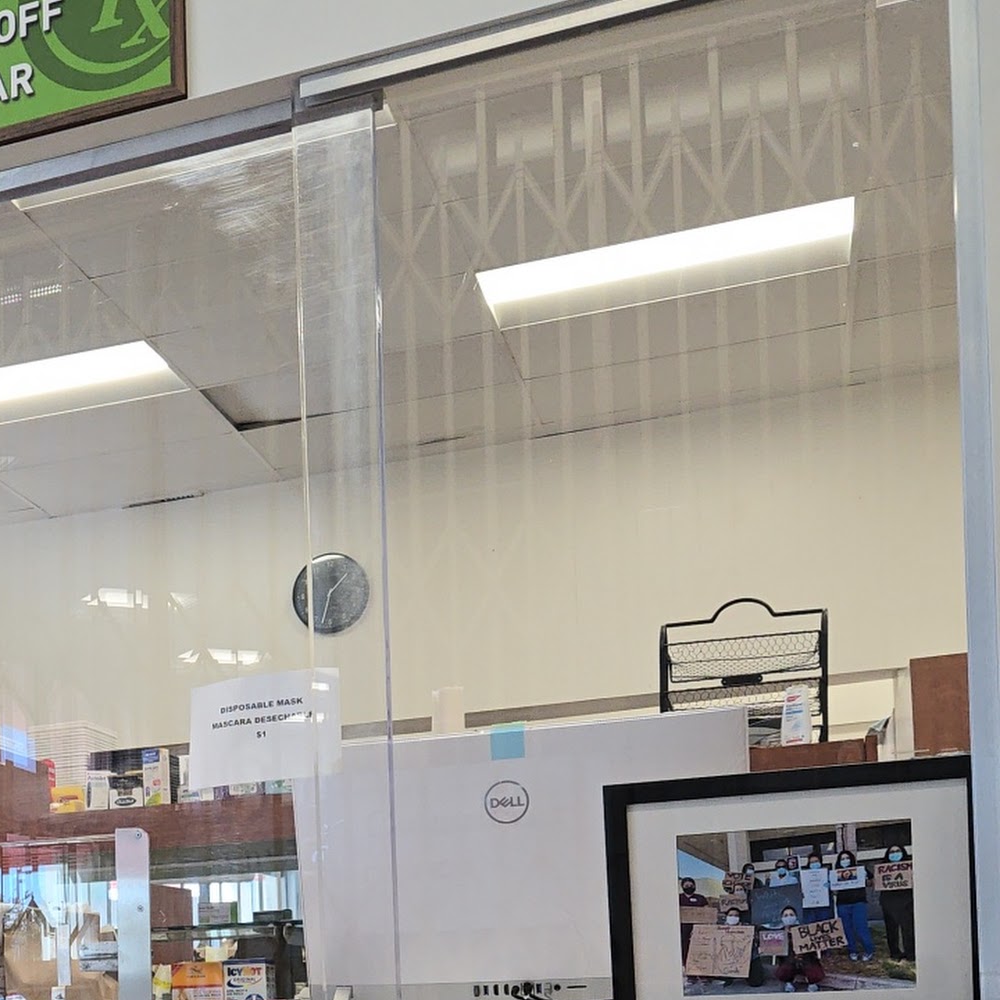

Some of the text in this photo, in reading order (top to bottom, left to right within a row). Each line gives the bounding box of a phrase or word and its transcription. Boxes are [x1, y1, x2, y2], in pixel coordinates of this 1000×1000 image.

[220, 697, 303, 714] DISPOSABLE MASK
[212, 717, 252, 730] MASCARA
[490, 796, 525, 809] DELL
[878, 862, 912, 874] RACISM
[763, 932, 783, 940] LOVE
[799, 921, 838, 938] BLACK
[799, 936, 844, 951] MATTER
[227, 967, 243, 976] ICY
